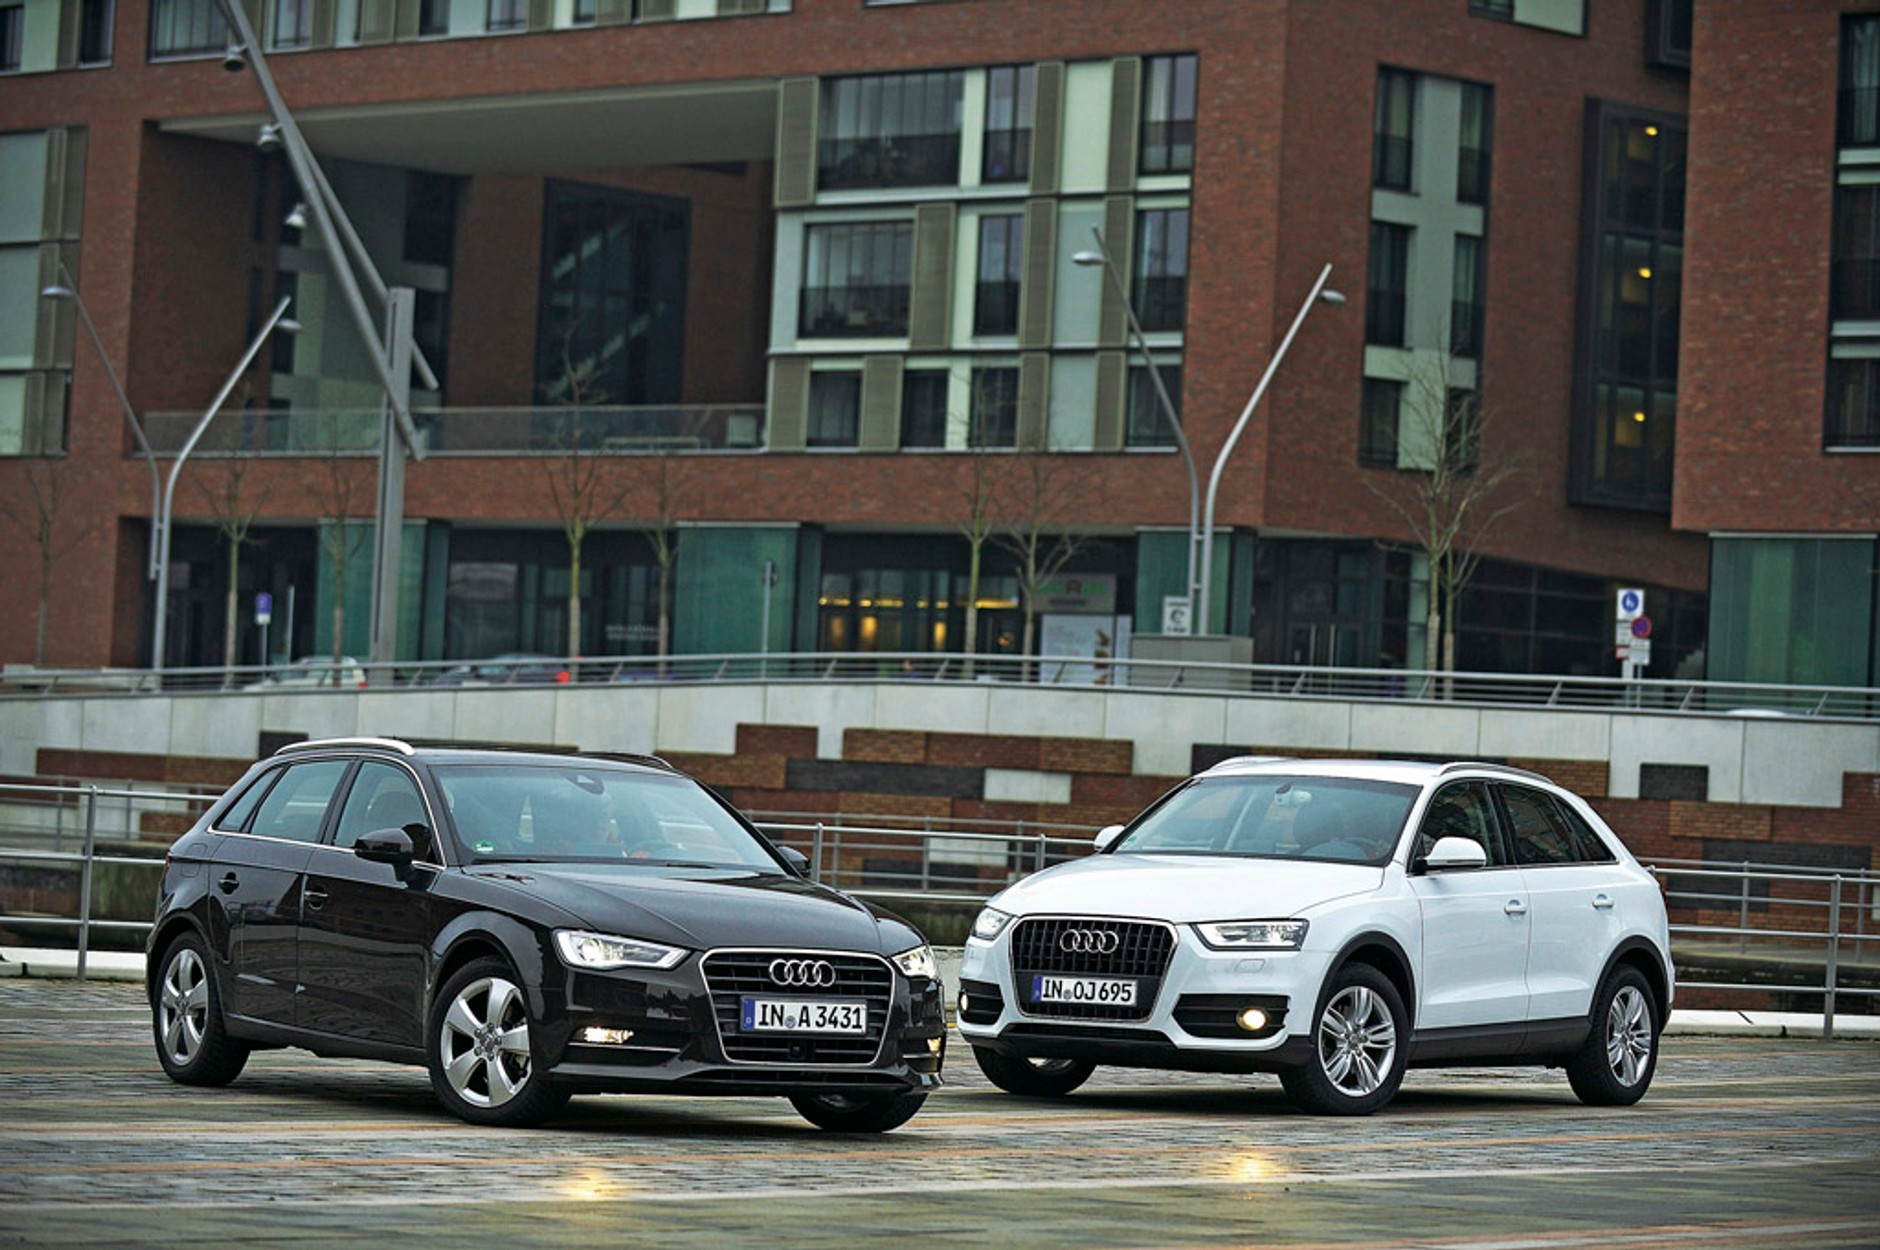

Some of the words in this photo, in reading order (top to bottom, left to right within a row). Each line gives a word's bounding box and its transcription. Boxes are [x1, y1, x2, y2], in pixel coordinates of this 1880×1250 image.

[1043, 979, 1063, 999] IN
[1099, 982, 1132, 1002] 695
[758, 1004, 785, 1027] IN
[798, 1005, 811, 1028] A
[815, 1006, 862, 1029] 3431
